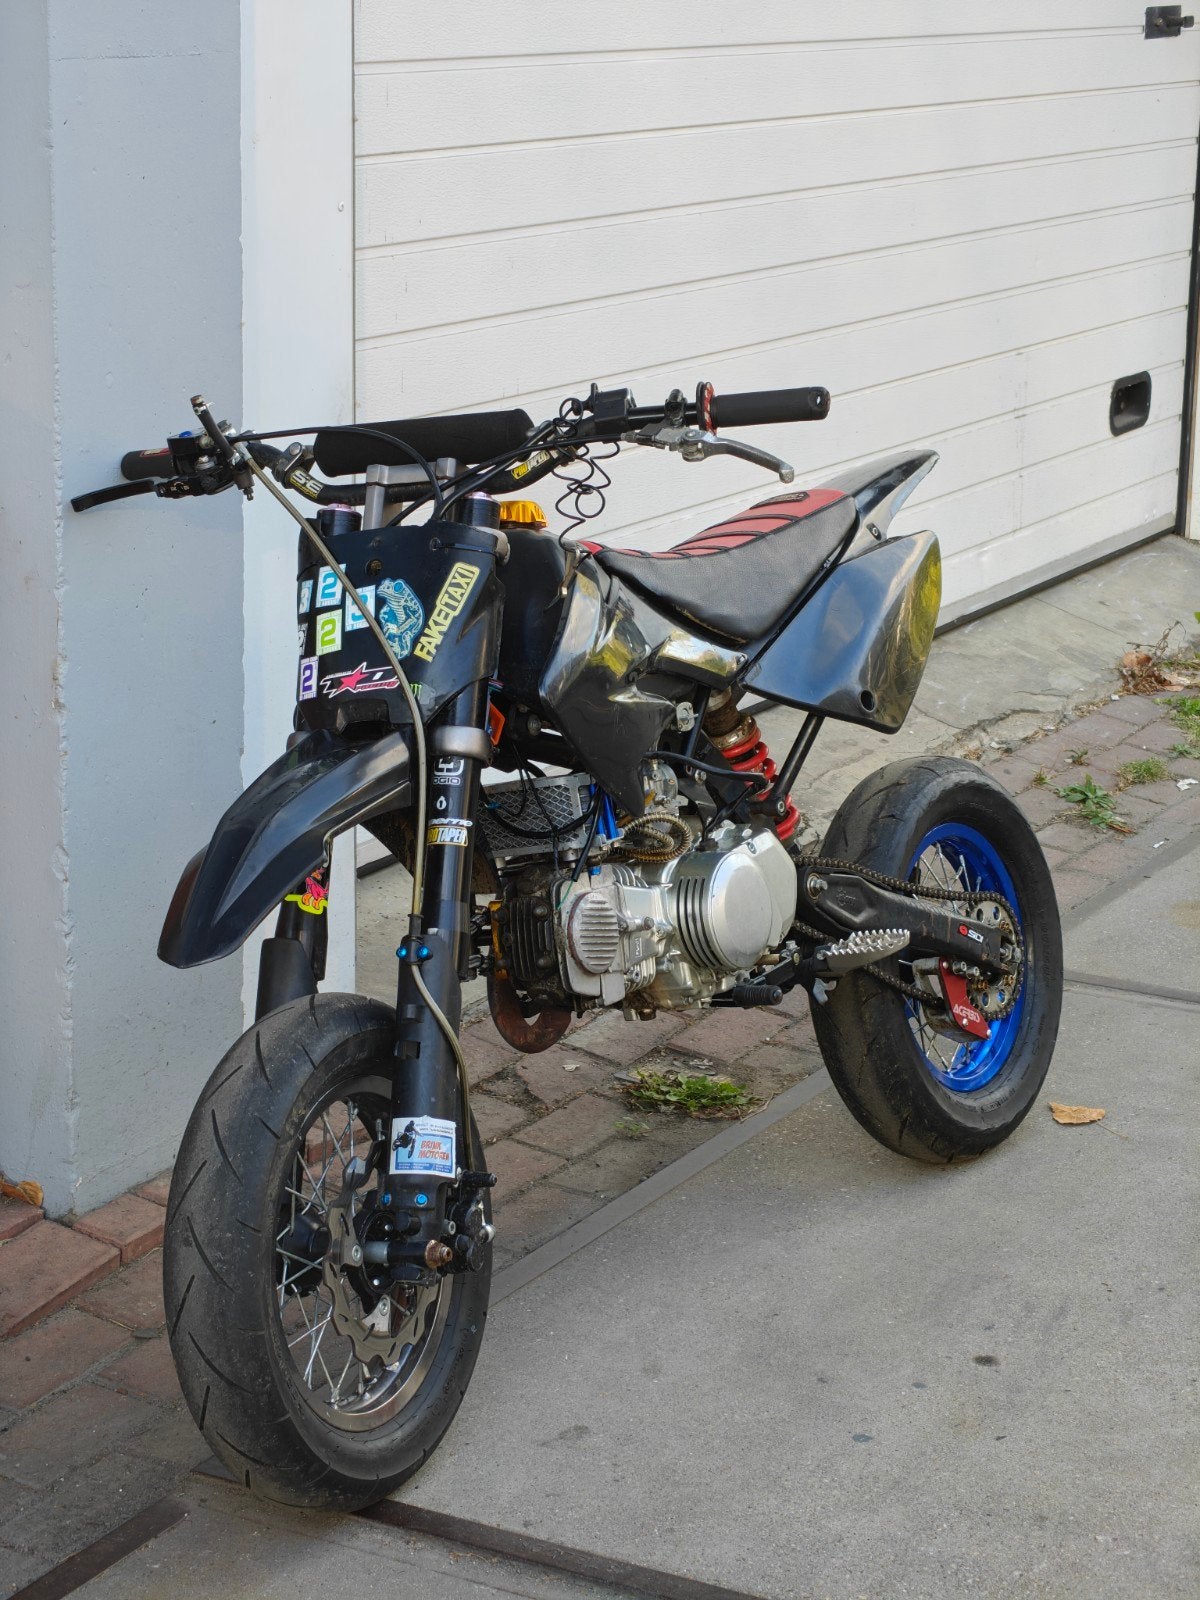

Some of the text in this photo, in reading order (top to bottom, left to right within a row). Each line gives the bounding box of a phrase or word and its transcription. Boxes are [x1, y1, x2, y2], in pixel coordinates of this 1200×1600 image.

[320, 571, 339, 600] 2
[320, 618, 337, 648] 2
[302, 663, 314, 693] 2
